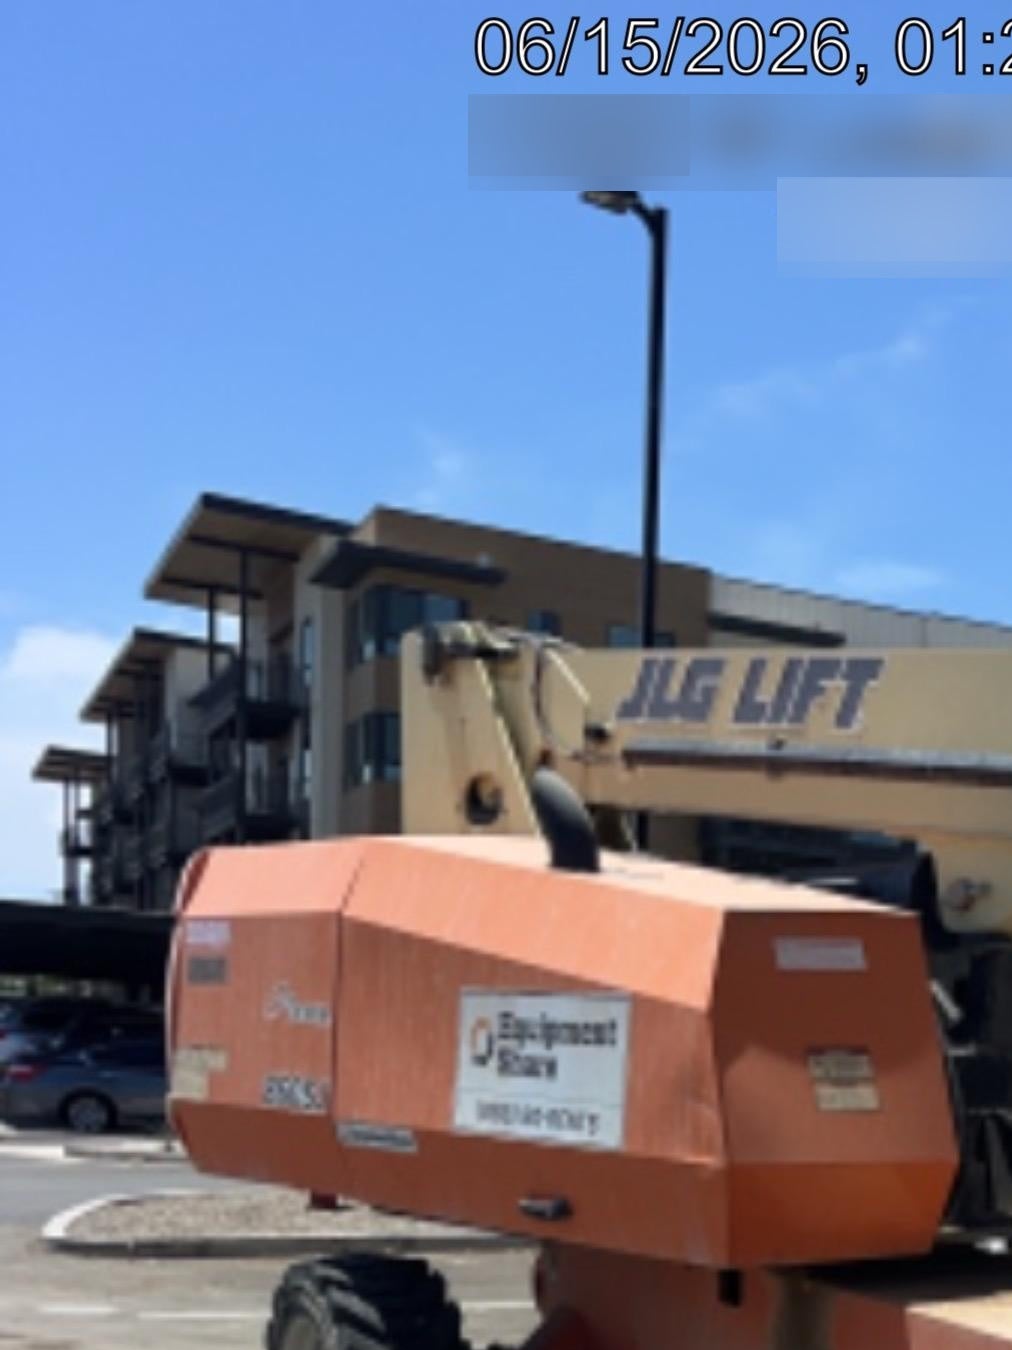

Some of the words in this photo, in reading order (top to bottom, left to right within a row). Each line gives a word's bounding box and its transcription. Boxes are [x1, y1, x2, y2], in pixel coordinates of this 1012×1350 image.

[615, 657, 727, 722] JLG
[732, 657, 886, 731] LIFT
[498, 1011, 617, 1050] Equipment
[498, 1048, 558, 1081] Share
